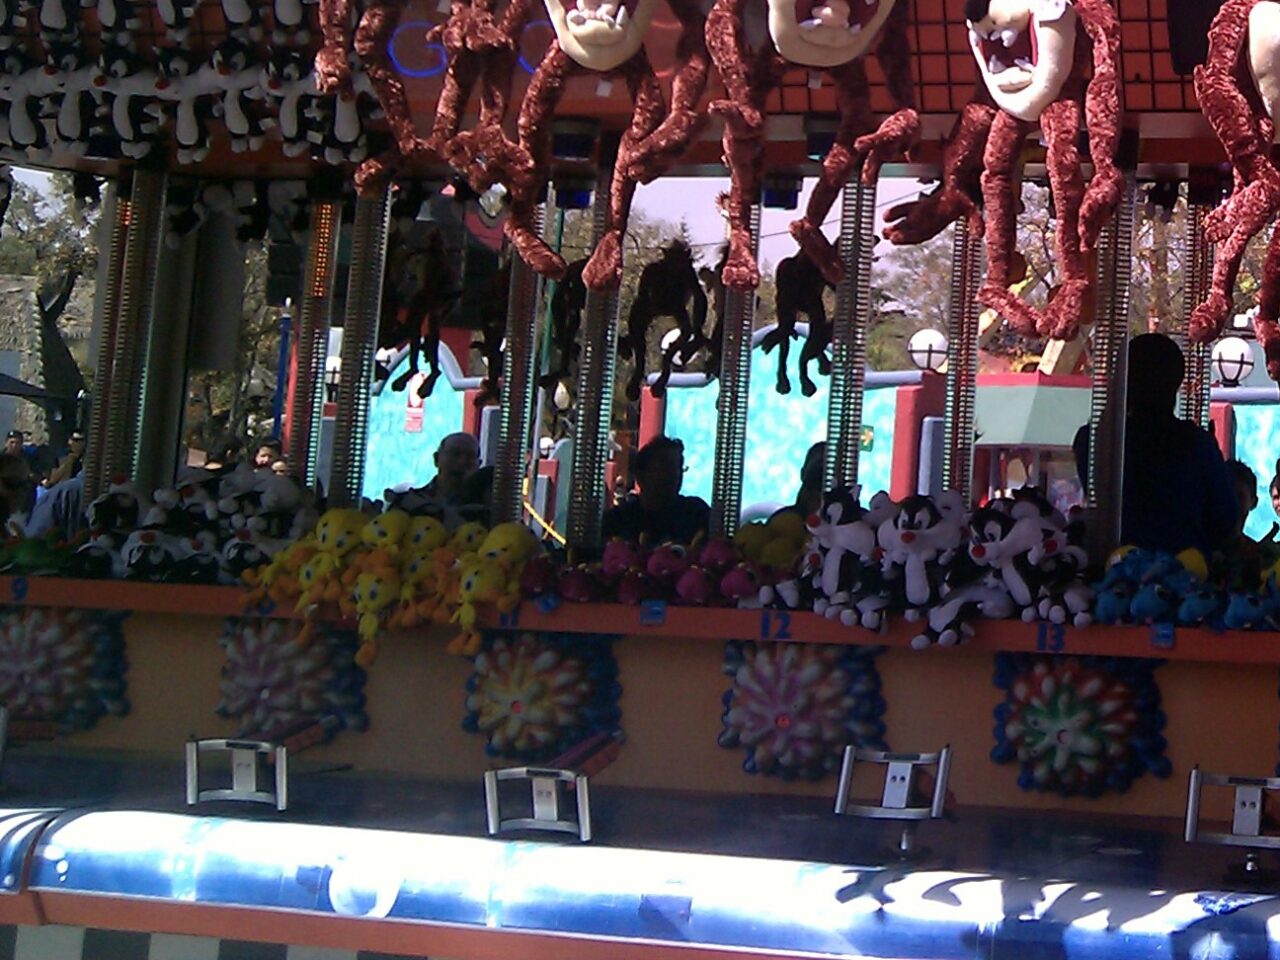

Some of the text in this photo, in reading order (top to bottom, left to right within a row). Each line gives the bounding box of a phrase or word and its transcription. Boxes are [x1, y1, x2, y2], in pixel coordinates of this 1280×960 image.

[11, 576, 28, 601] 9
[761, 611, 792, 640] 12
[1037, 621, 1065, 651] 13
